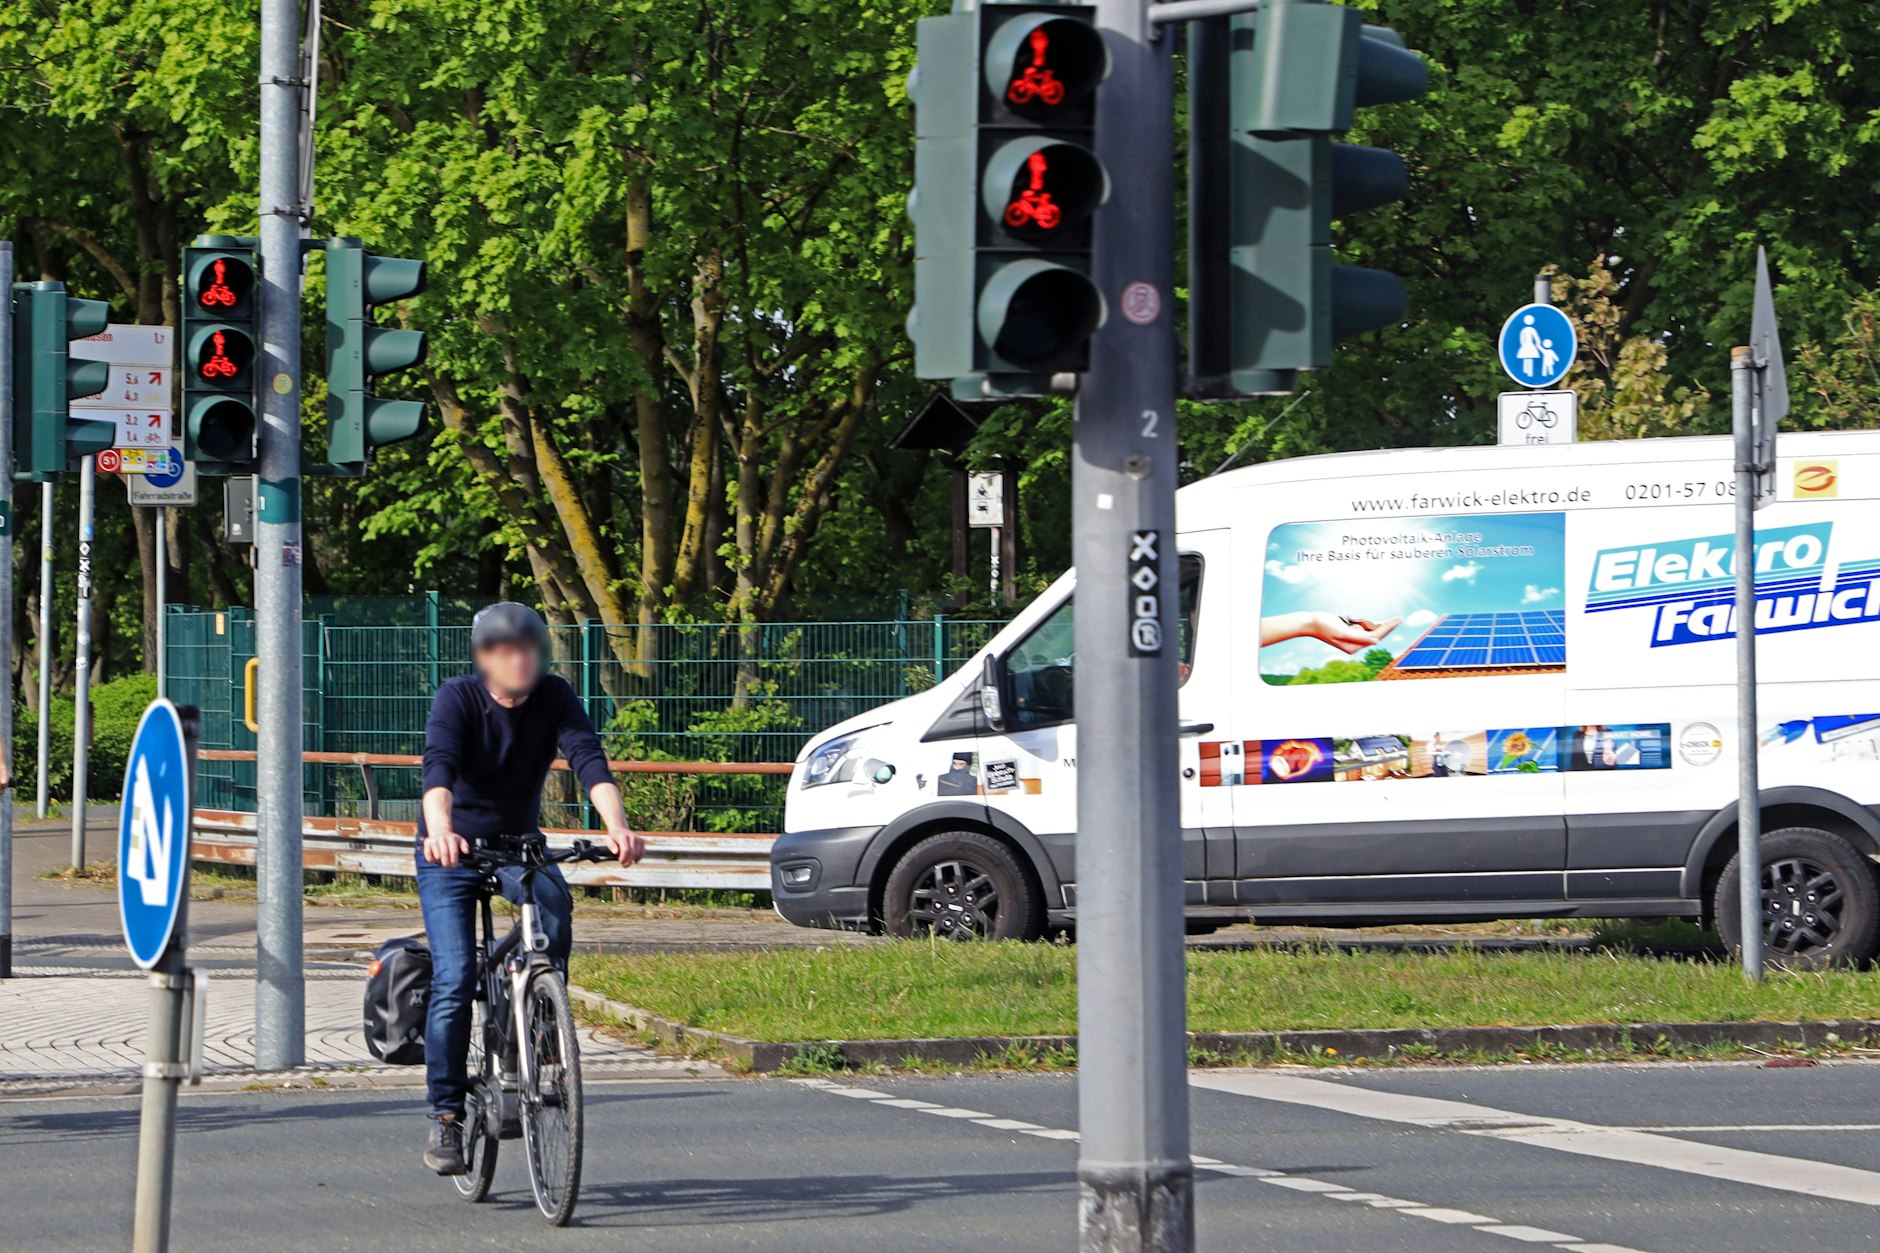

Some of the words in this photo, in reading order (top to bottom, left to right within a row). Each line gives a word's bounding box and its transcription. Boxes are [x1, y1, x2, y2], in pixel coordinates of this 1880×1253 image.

[1141, 409, 1158, 438] 2
[1525, 433, 1550, 445] frei
[133, 491, 192, 501] Fahrradstraße
[1351, 485, 1591, 512] www.farwick-elektro.de
[1625, 482, 1706, 500] 0201-57
[1342, 530, 1483, 546] Photovoltaik-Anlage
[1296, 551, 1323, 562] Ihre
[1328, 549, 1361, 561] Basis
[1366, 548, 1386, 560] für
[1390, 547, 1453, 559] sauberen
[1456, 544, 1534, 558] Solarstrom
[1594, 534, 1823, 591] Elekro
